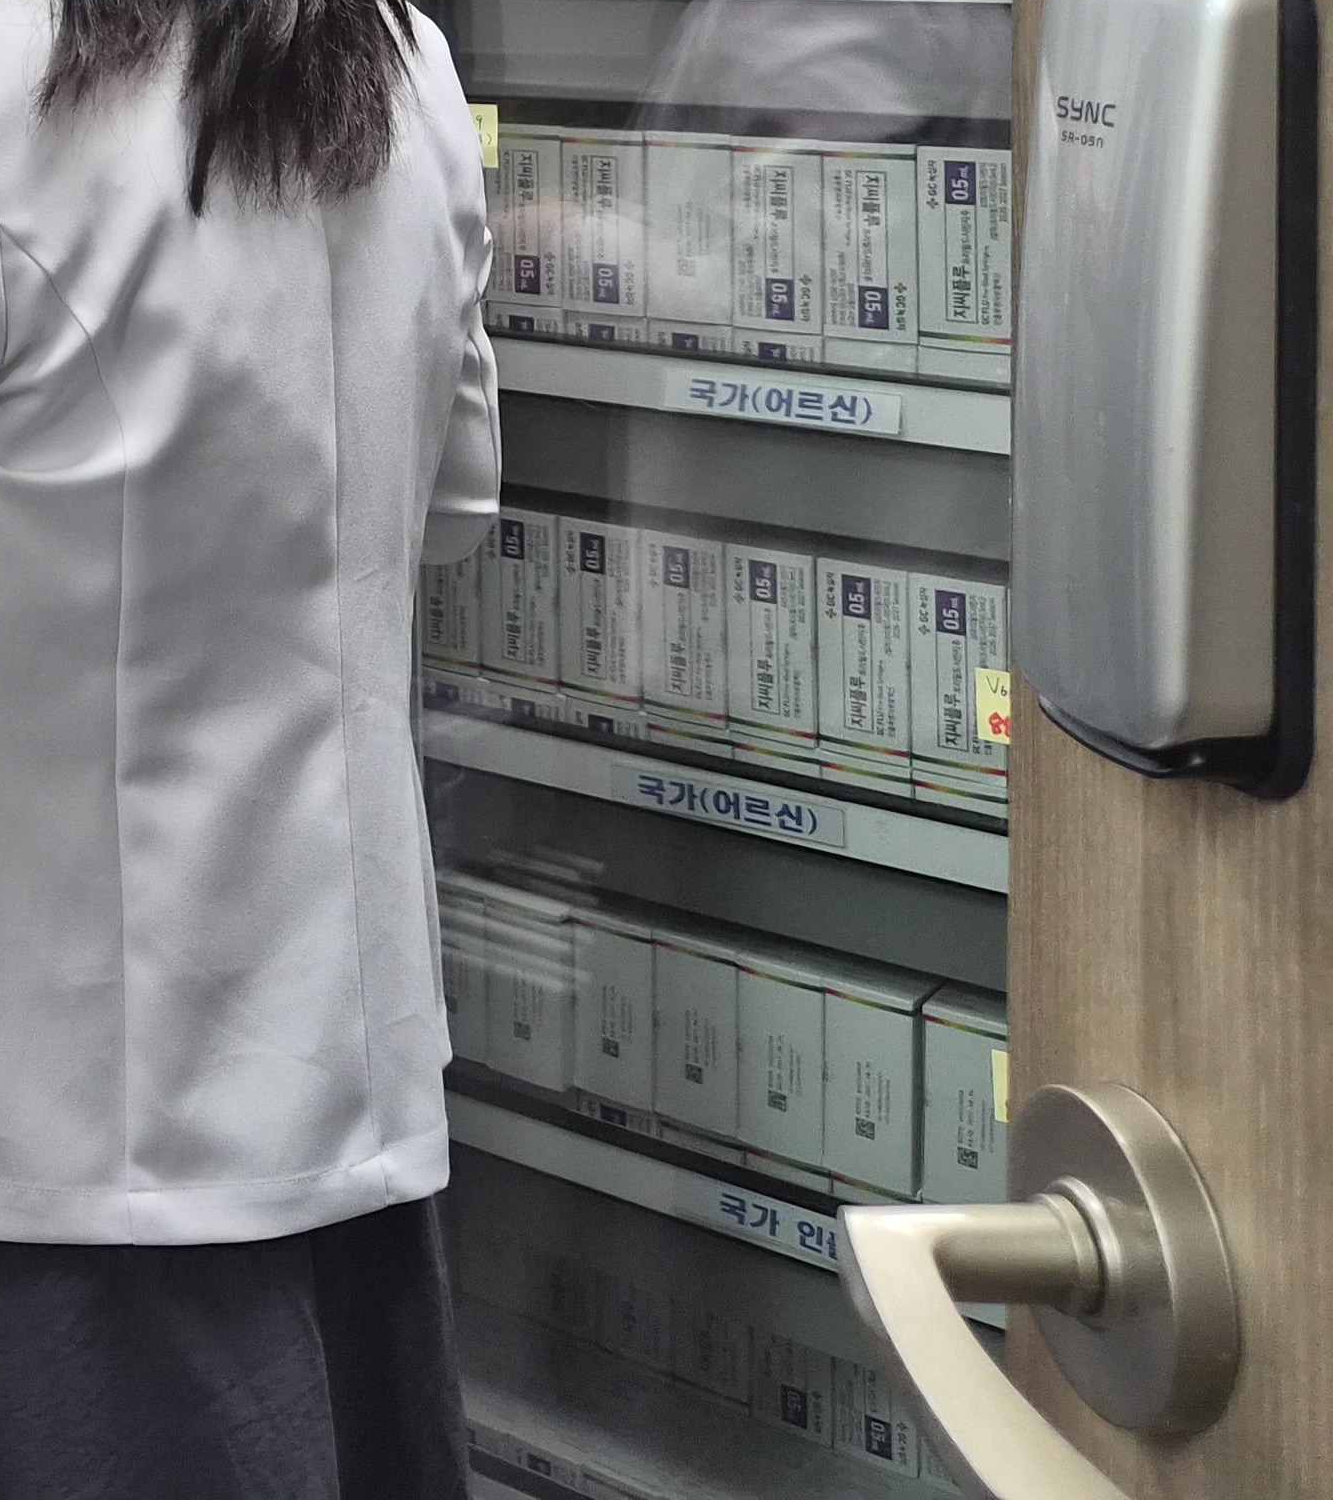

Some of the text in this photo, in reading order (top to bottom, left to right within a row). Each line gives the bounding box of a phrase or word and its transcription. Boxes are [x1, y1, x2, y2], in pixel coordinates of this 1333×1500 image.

[1056, 95, 1116, 127] SYNC
[596, 159, 613, 208] 지씨플루
[769, 170, 788, 220] 지씨플루
[861, 174, 881, 227] 지씨플루
[952, 265, 972, 319] 지씨플루
[688, 377, 873, 425] 국가(어르신)
[756, 658, 774, 710] 지씨플루
[849, 675, 867, 728] 지씨플루
[944, 693, 963, 746] 지씨플루
[637, 773, 817, 835] 국가(어르신)
[719, 1192, 780, 1237] 국가
